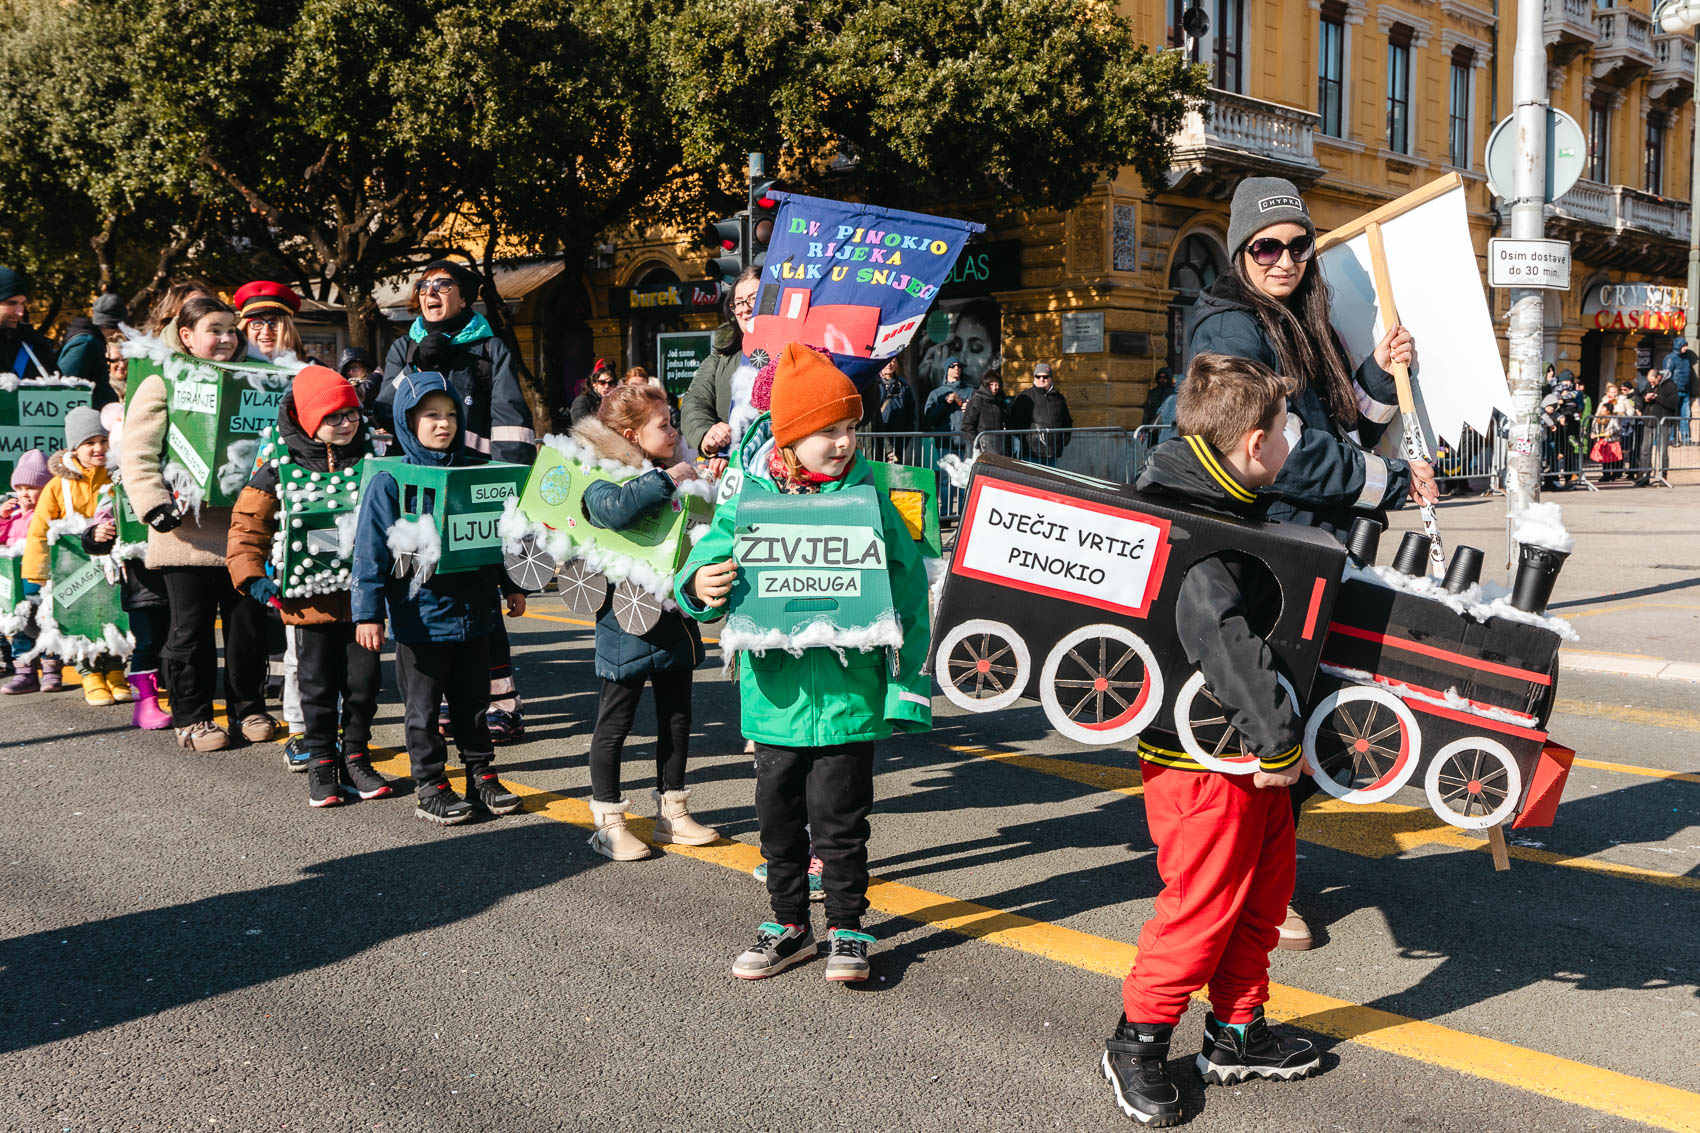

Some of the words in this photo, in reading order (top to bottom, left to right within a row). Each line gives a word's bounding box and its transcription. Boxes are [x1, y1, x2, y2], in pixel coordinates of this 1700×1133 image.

[836, 225, 948, 255] PINOKIO
[807, 242, 902, 266] RIJEKA
[1500, 250, 1527, 260] Osim
[1531, 251, 1566, 264] dostave
[769, 261, 822, 280] VLAK
[831, 266, 849, 282] U
[943, 253, 990, 285] LAS
[1509, 265, 1521, 275] do
[1526, 265, 1539, 275] 30
[629, 285, 682, 309] burek
[1594, 309, 1686, 331] CASINO
[22, 400, 59, 417] KAD
[176, 390, 216, 409] IGRANJE
[242, 391, 284, 408] VLAK
[0, 436, 45, 453] MALE
[475, 486, 515, 500] SLOGA
[987, 508, 1068, 542] DJEČJI
[1078, 528, 1145, 560] VRTIĆ
[740, 526, 882, 565] ŽIVJELA
[1008, 547, 1106, 585] PINOKIO
[765, 576, 858, 593] ZADRUGA
